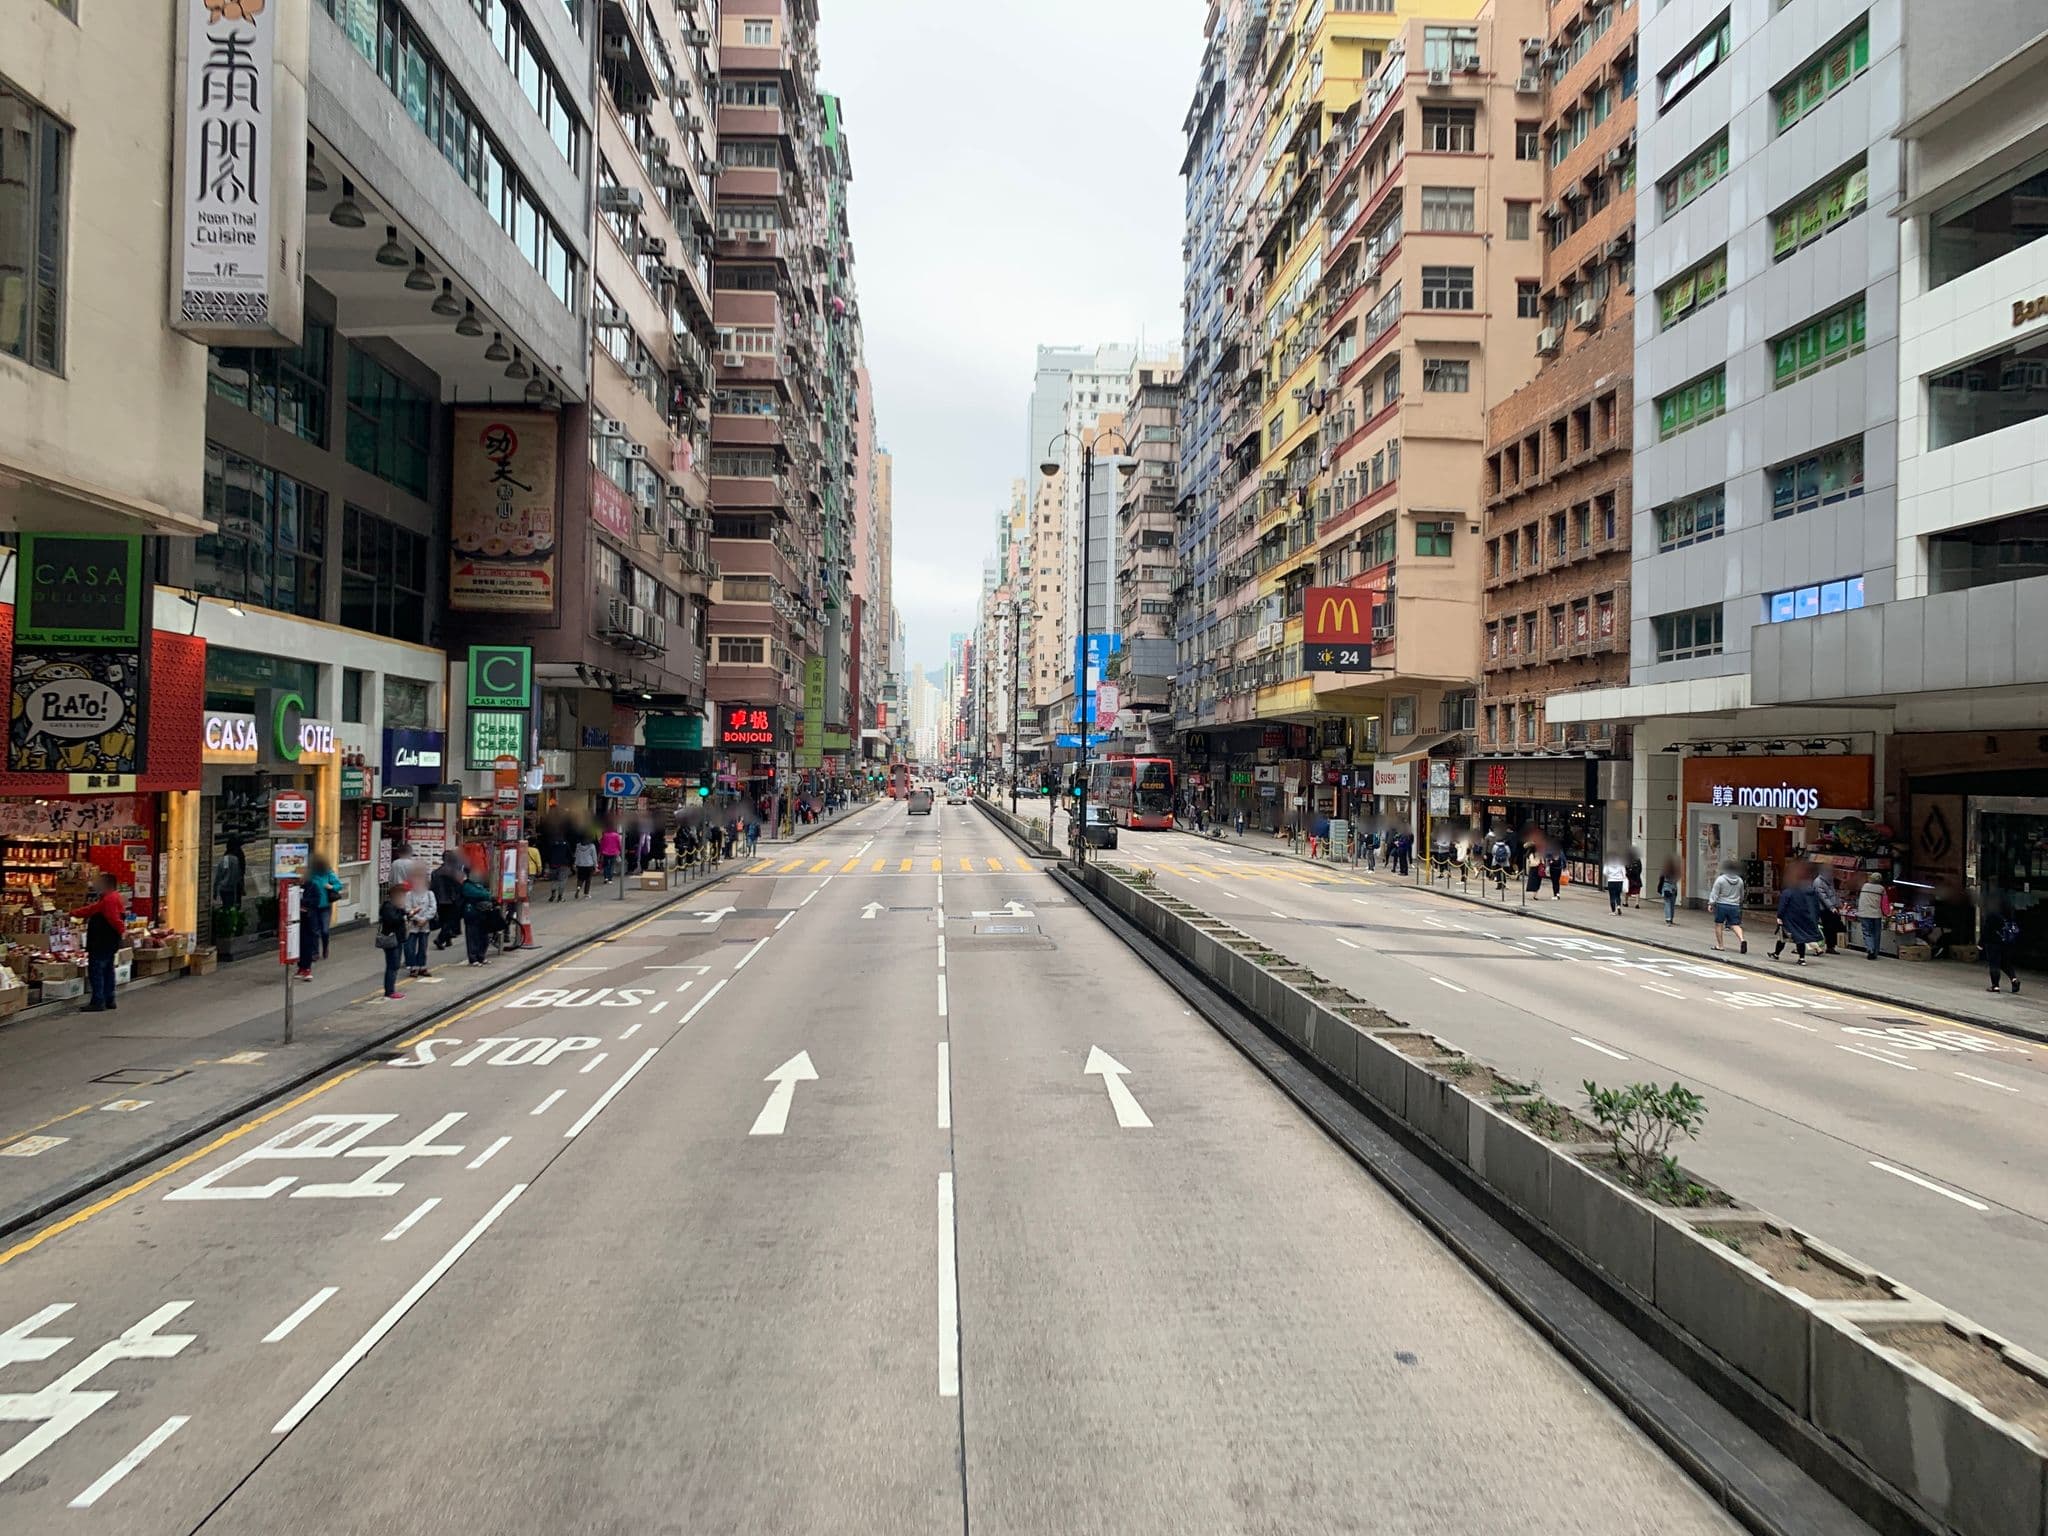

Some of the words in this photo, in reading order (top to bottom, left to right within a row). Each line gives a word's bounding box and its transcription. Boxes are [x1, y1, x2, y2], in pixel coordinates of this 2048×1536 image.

[197, 226, 257, 244] Cuisine
[214, 262, 239, 277] 1/F
[35, 564, 123, 585] CASA
[15, 633, 46, 642] CASA
[51, 634, 97, 643] DELUXE
[102, 635, 138, 644] HOTEL
[1340, 651, 1359, 665] 24
[42, 691, 108, 722] PLATO!
[500, 698, 523, 706] HOTEL
[206, 717, 258, 752] CASA
[723, 731, 773, 744] BONJOUR
[1381, 773, 1397, 785] SUSHI
[1738, 781, 1818, 816] mannings
[504, 988, 656, 1008] BUS
[387, 1036, 602, 1067] STOP
[163, 1112, 468, 1200] 巴士
